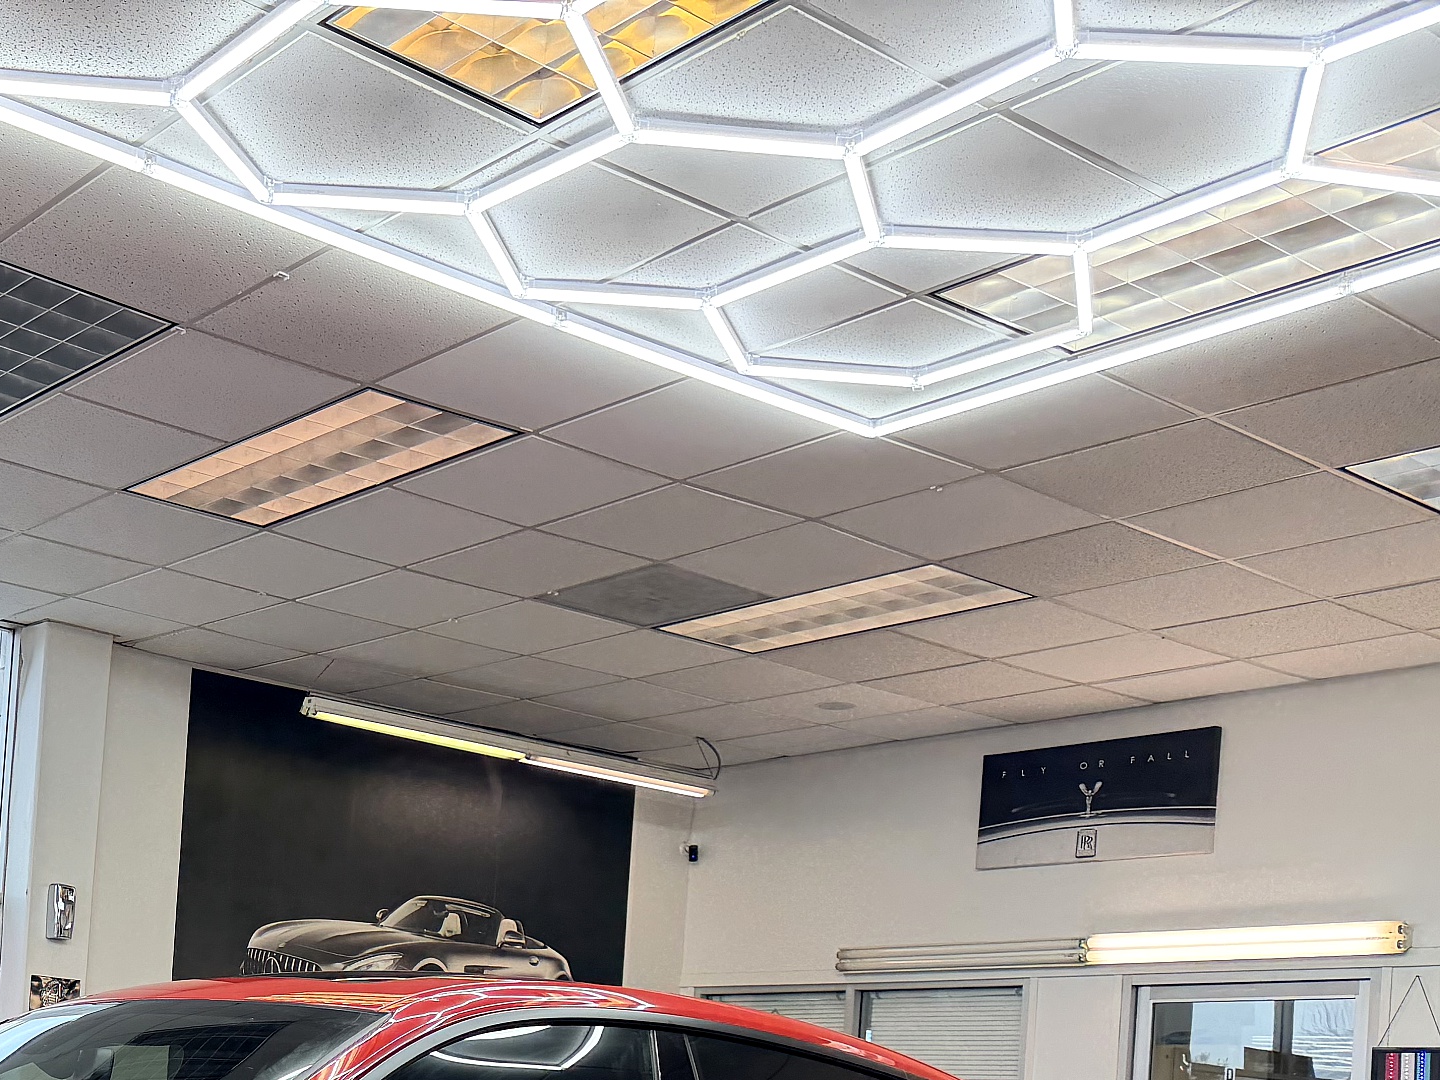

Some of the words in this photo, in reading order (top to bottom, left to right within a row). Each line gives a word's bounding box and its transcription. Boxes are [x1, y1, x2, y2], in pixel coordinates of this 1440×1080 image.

[1001, 766, 1047, 779] FLY
[1079, 759, 1105, 770] OR
[1130, 750, 1190, 764] FALL
